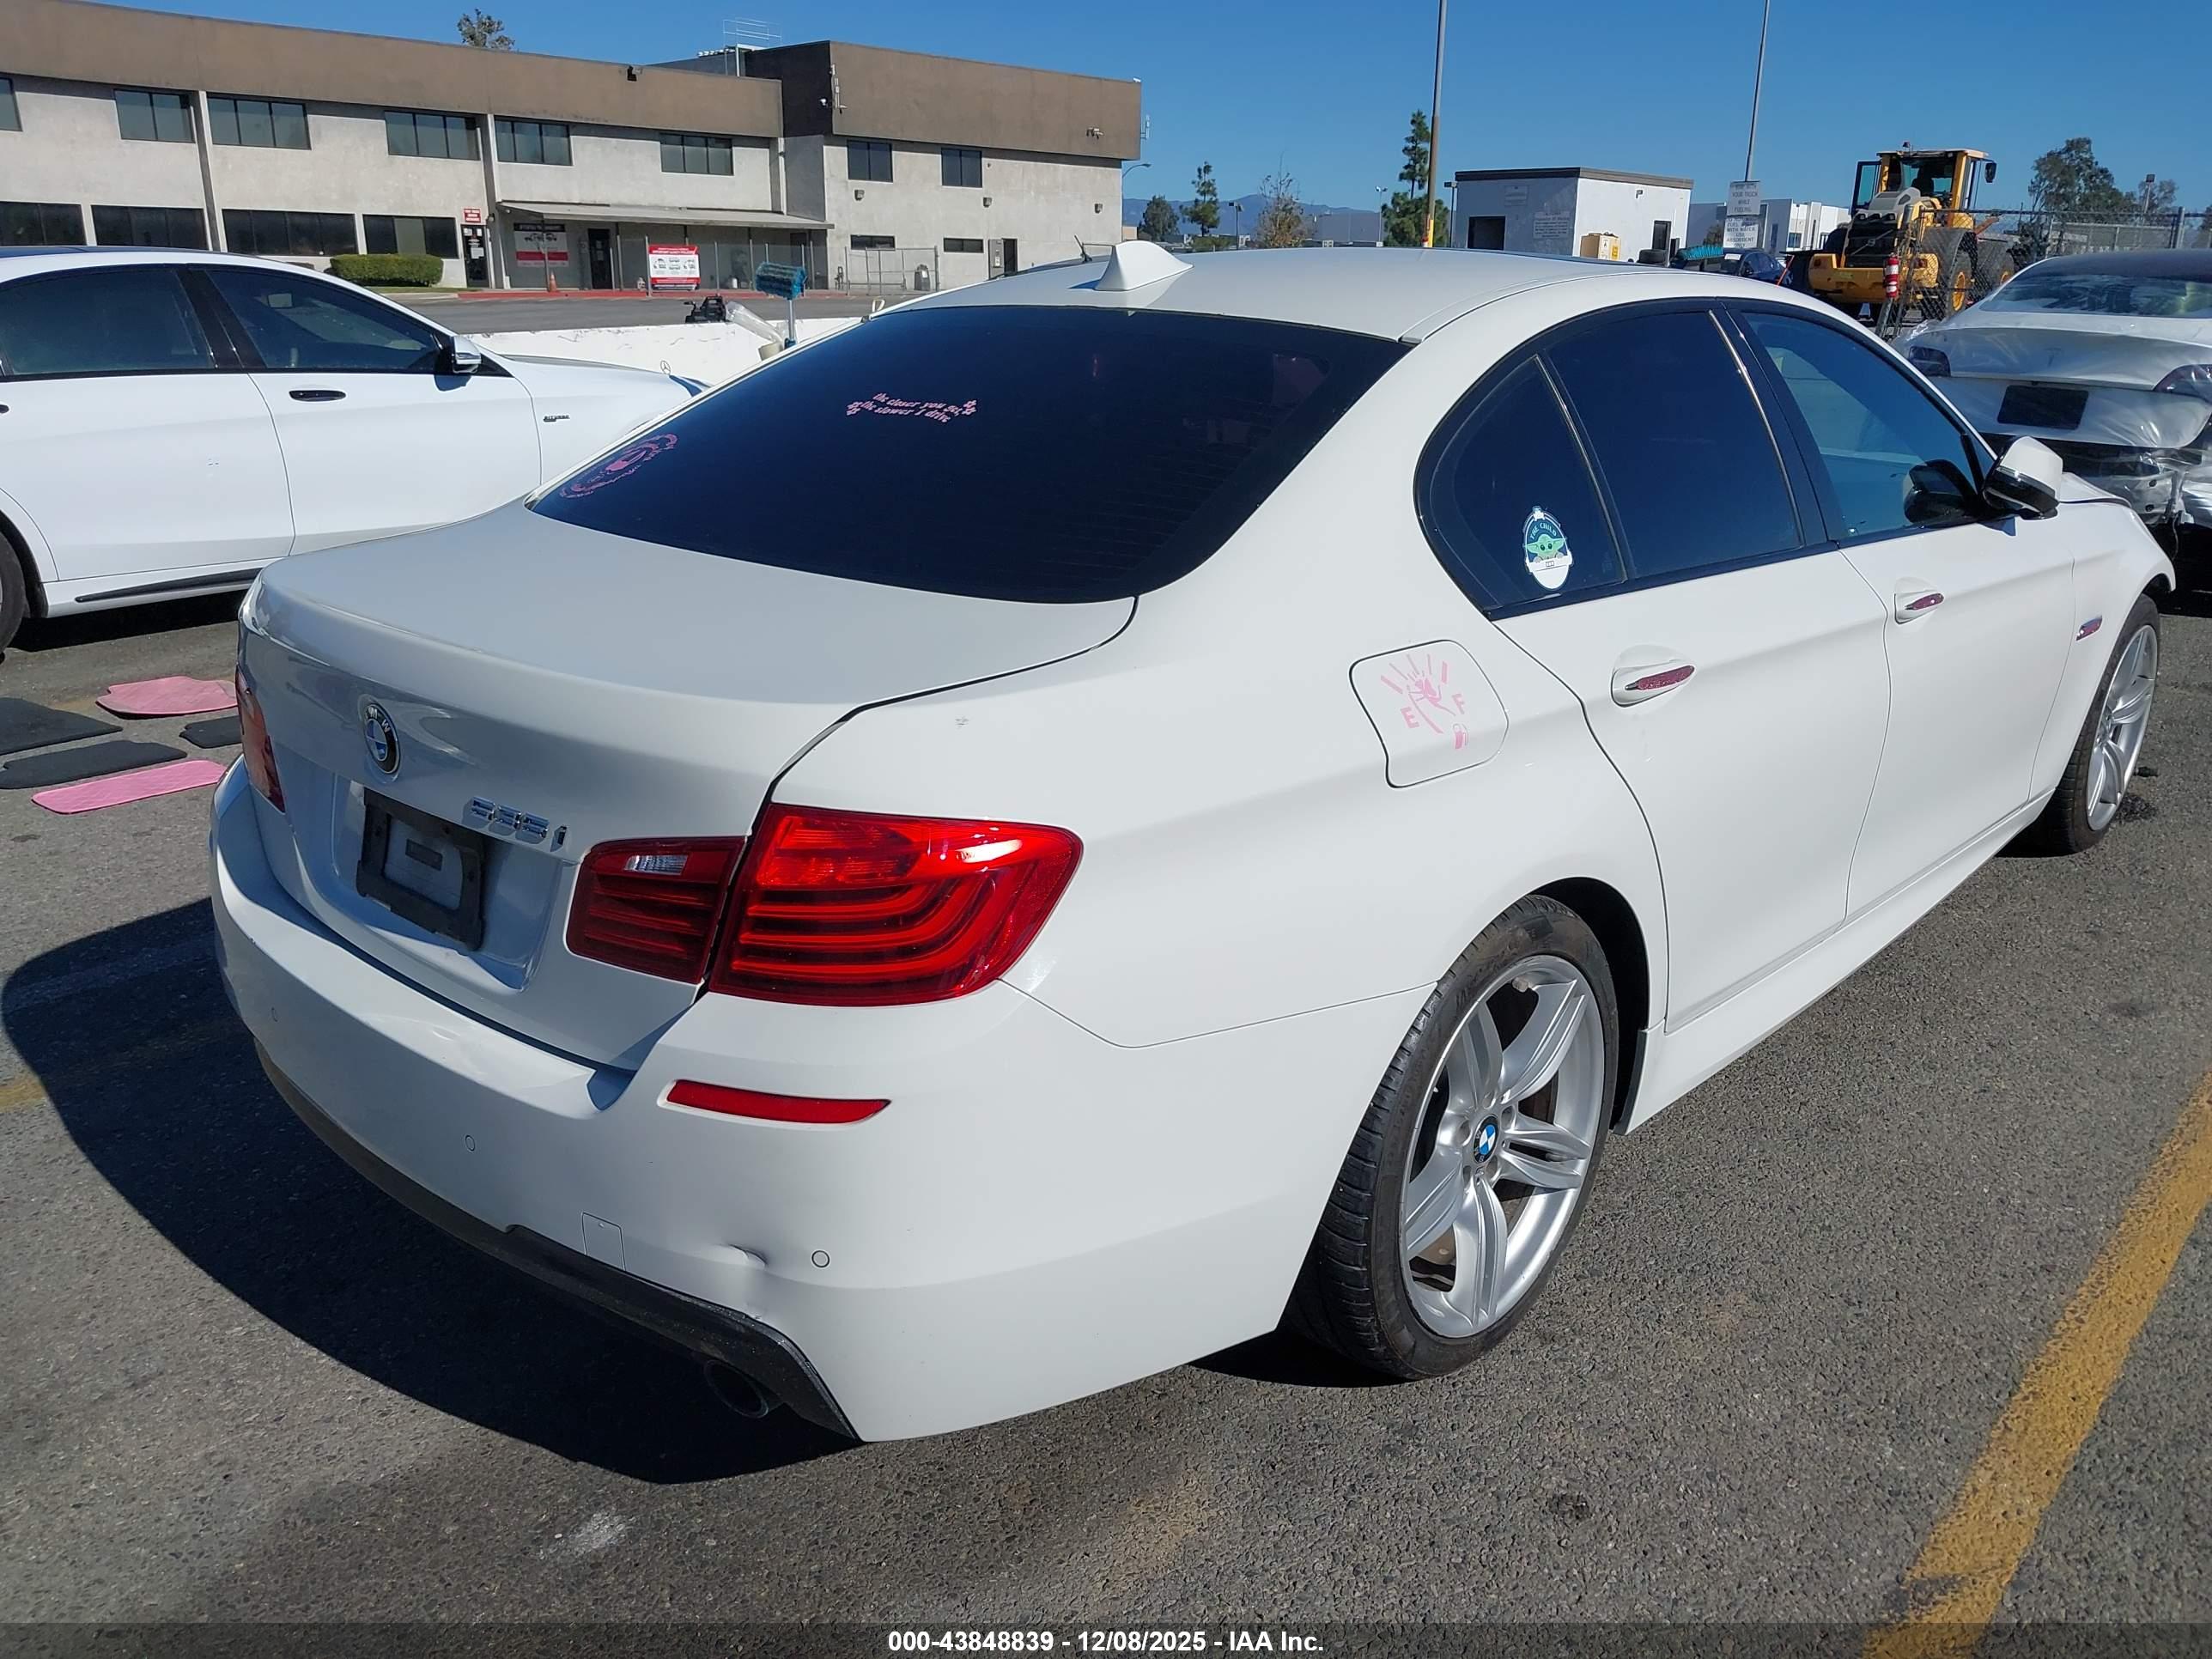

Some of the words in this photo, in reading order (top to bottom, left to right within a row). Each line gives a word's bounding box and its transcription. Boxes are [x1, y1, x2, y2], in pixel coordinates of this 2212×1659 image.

[872, 392, 890, 403] the
[886, 398, 921, 408] closer
[860, 400, 877, 410] the
[874, 406, 915, 416] slower
[924, 410, 951, 423] drive
[1529, 525, 1540, 540] THE
[1540, 522, 1558, 537] CHILD
[1400, 706, 1420, 729] E
[1451, 693, 1465, 715] F
